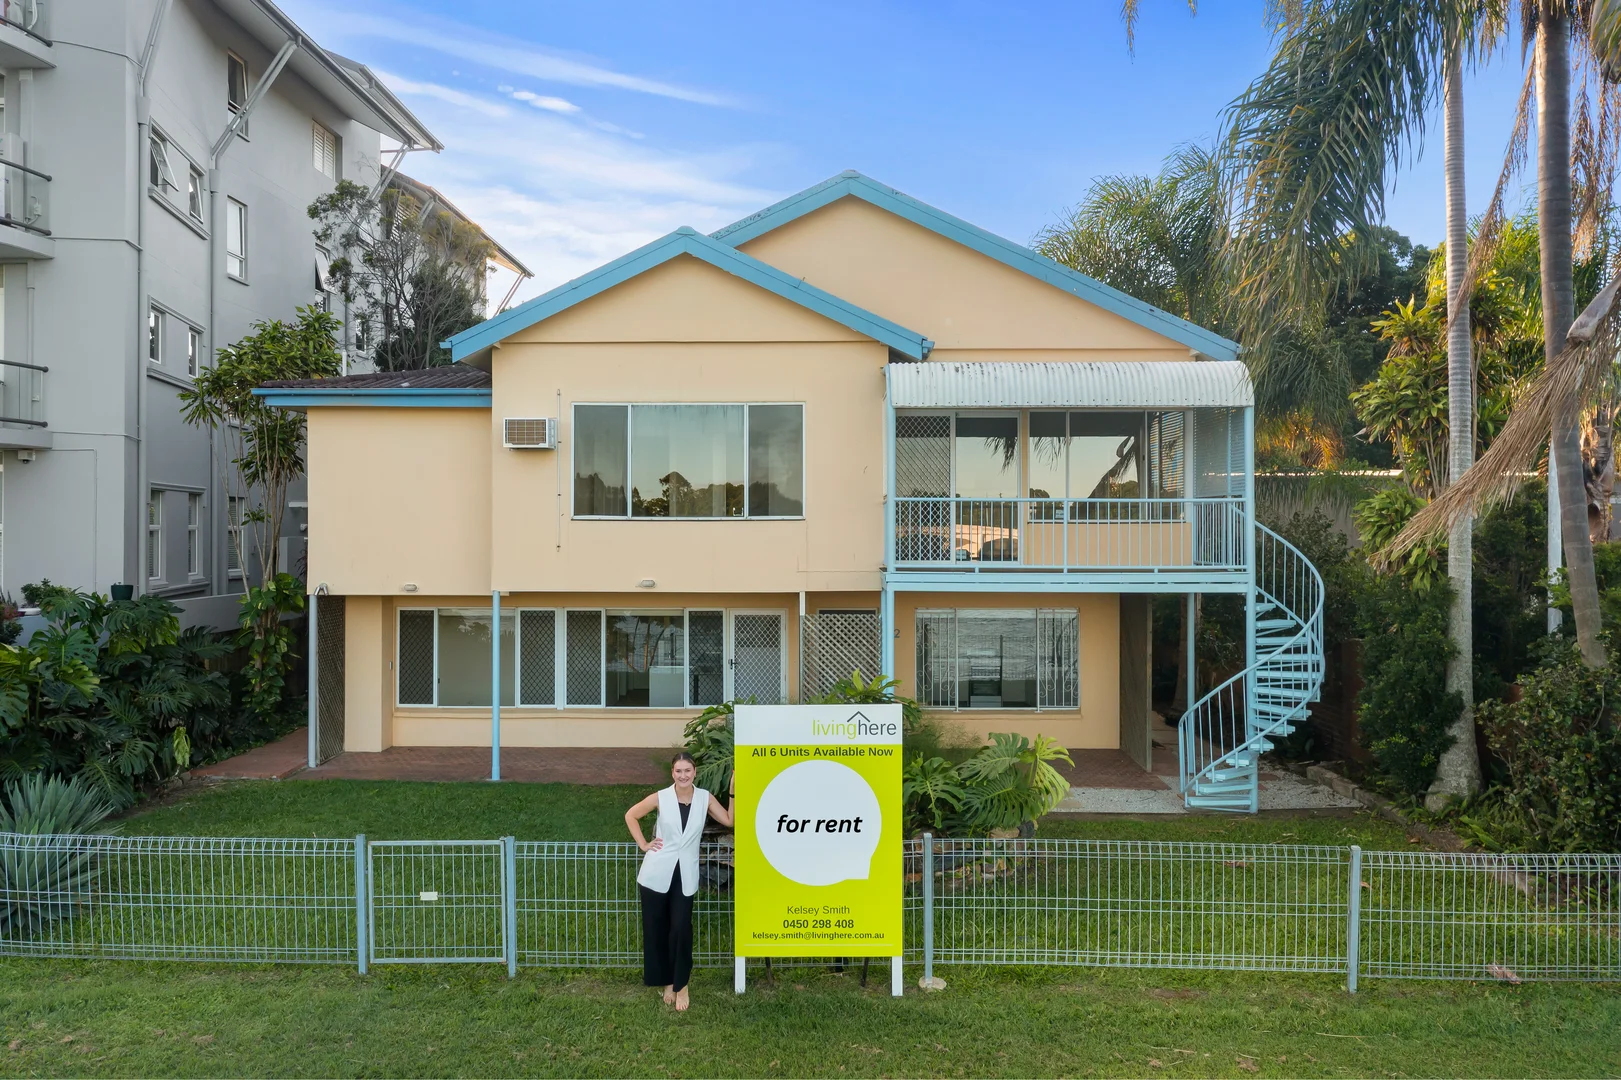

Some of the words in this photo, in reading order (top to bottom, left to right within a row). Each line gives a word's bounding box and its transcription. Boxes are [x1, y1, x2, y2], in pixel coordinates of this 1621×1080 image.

[812, 719, 897, 740] livinghere
[752, 747, 767, 757] All
[770, 747, 777, 757] 6
[780, 747, 810, 757] Units
[813, 747, 865, 757] Available
[868, 747, 893, 757] Now
[777, 814, 811, 834] for
[815, 816, 863, 834] rent
[787, 905, 820, 916] Kelsey
[822, 905, 850, 915] Smith
[783, 919, 809, 929] 0450
[812, 919, 832, 929] 298
[835, 919, 855, 929] 408
[752, 931, 885, 941] kelsey.smith@livinghere.com.au
